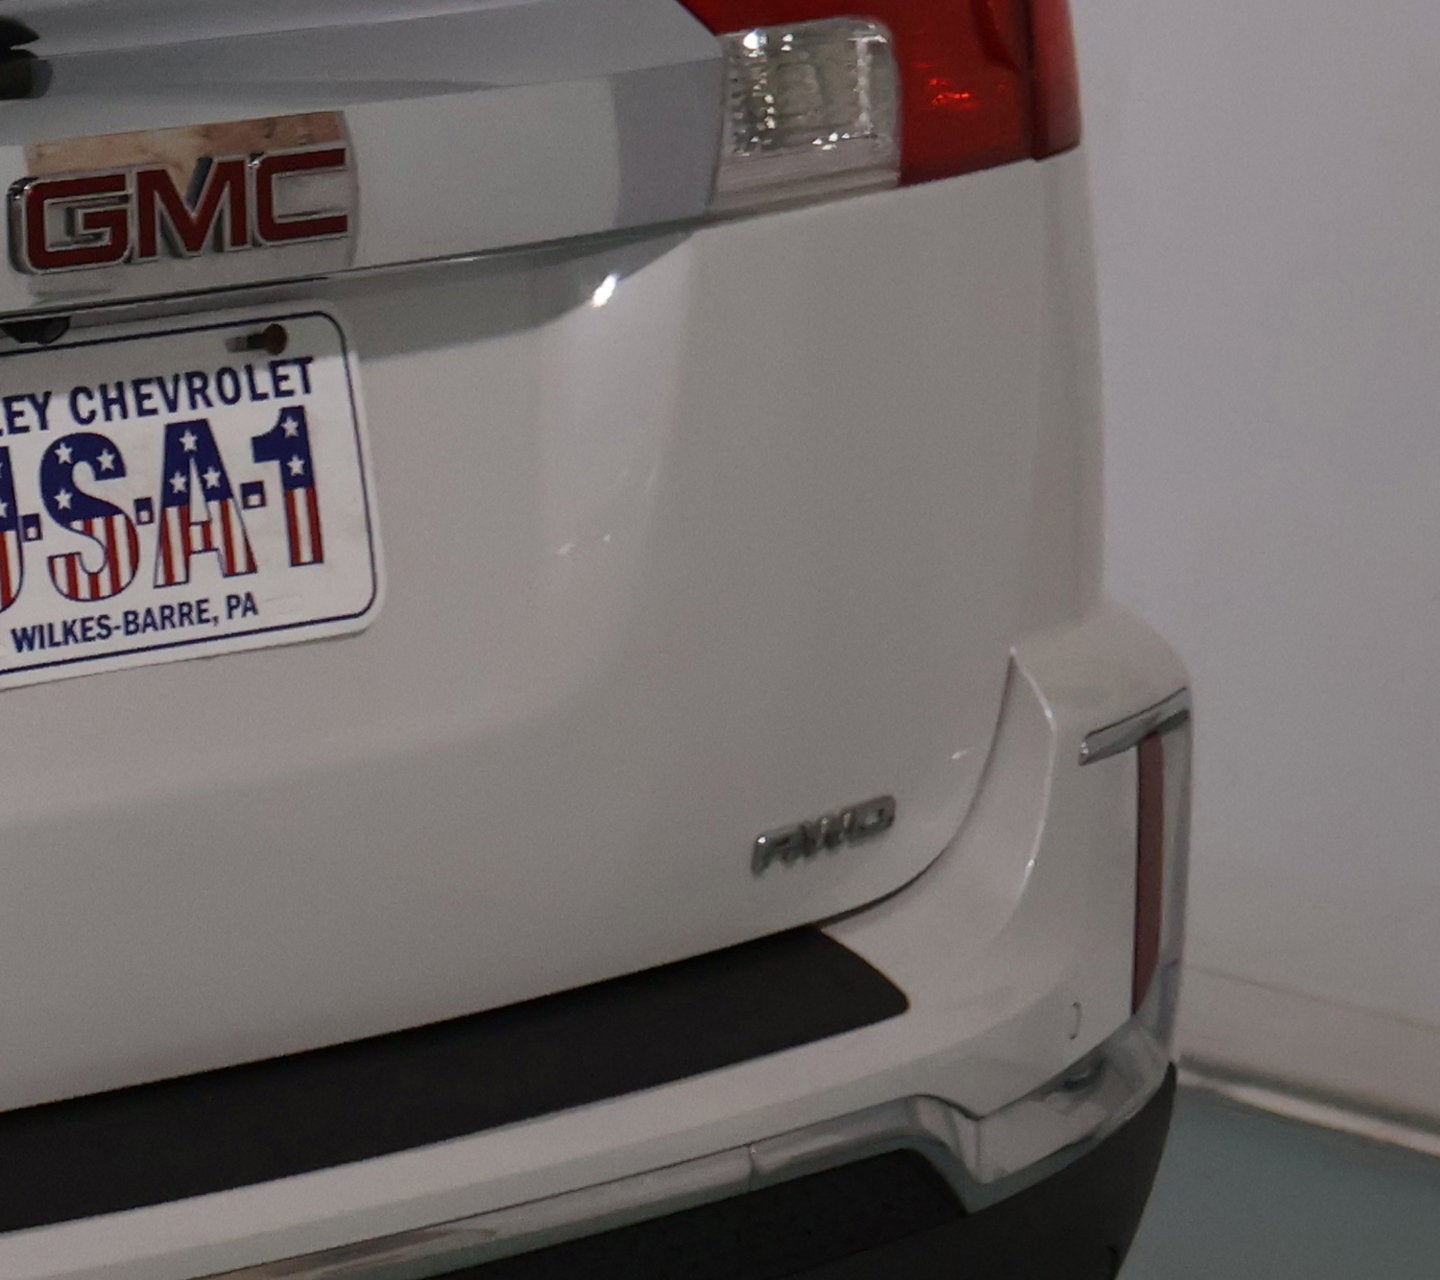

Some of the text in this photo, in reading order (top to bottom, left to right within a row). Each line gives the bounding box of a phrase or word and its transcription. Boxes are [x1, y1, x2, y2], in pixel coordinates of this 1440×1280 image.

[7, 142, 351, 275] GMC
[69, 355, 316, 426] CHEVROLET
[11, 591, 259, 654] WILKES-BARRE, PA
